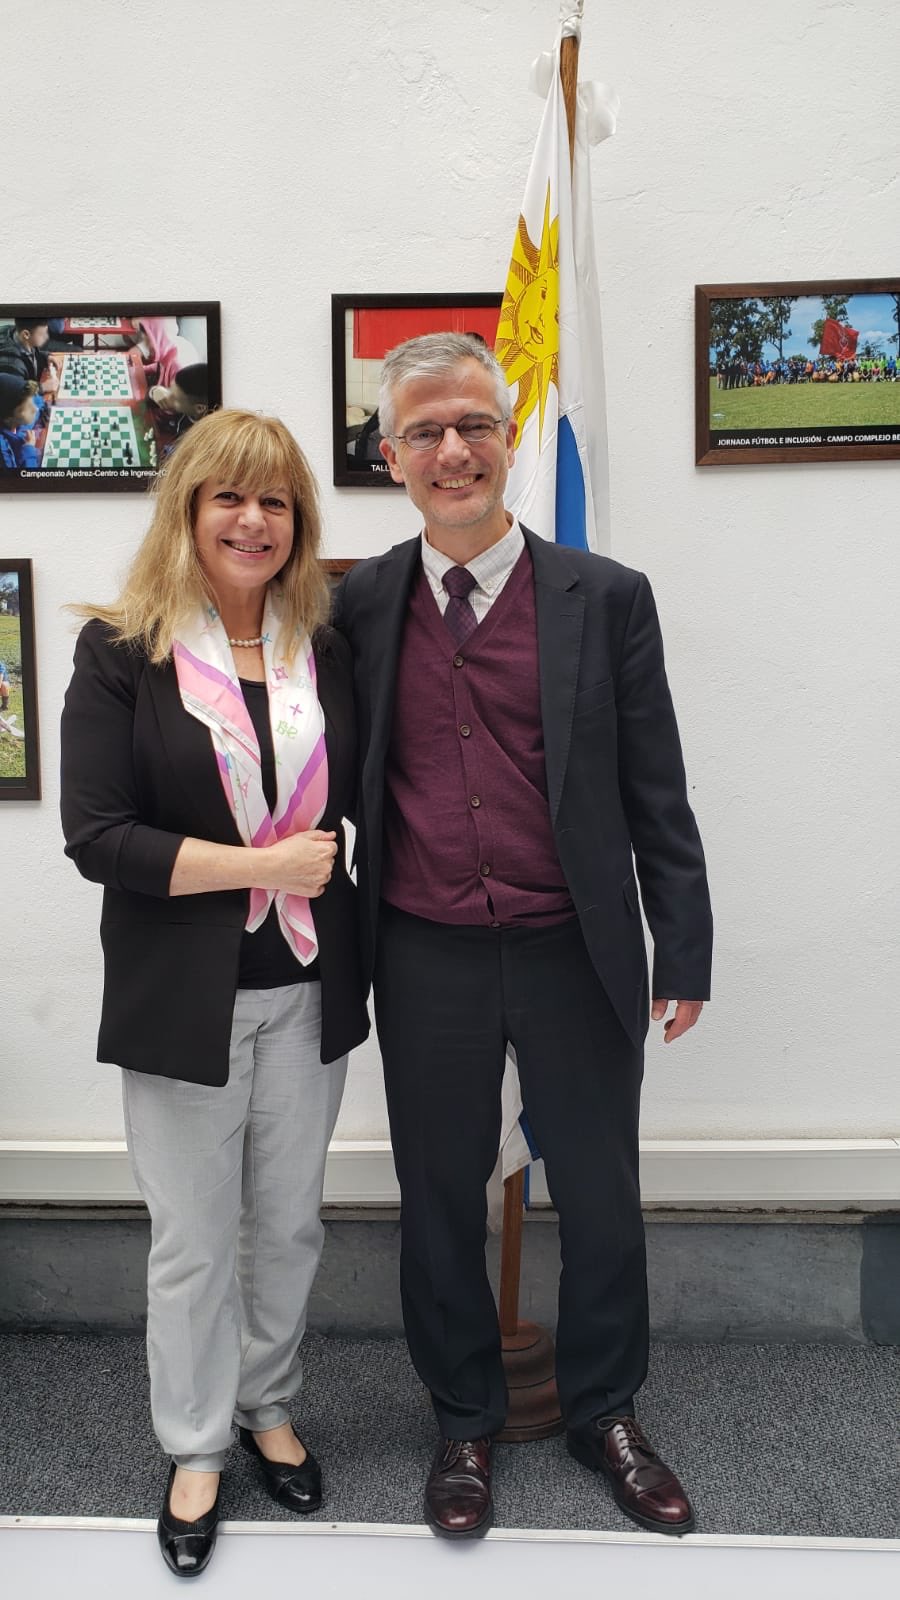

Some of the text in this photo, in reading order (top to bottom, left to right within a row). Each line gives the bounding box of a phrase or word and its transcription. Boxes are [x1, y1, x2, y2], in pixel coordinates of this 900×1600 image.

[718, 438, 751, 446] JORNADA
[751, 437, 778, 445] FÚTBOL
[785, 435, 822, 444] INCLUSIÓN
[827, 435, 853, 443] CAMPO
[855, 434, 891, 442] COMPLEJO
[20, 470, 65, 479] Campeonato
[66, 469, 118, 478] Ajedrez-Centro
[120, 469, 130, 477] de
